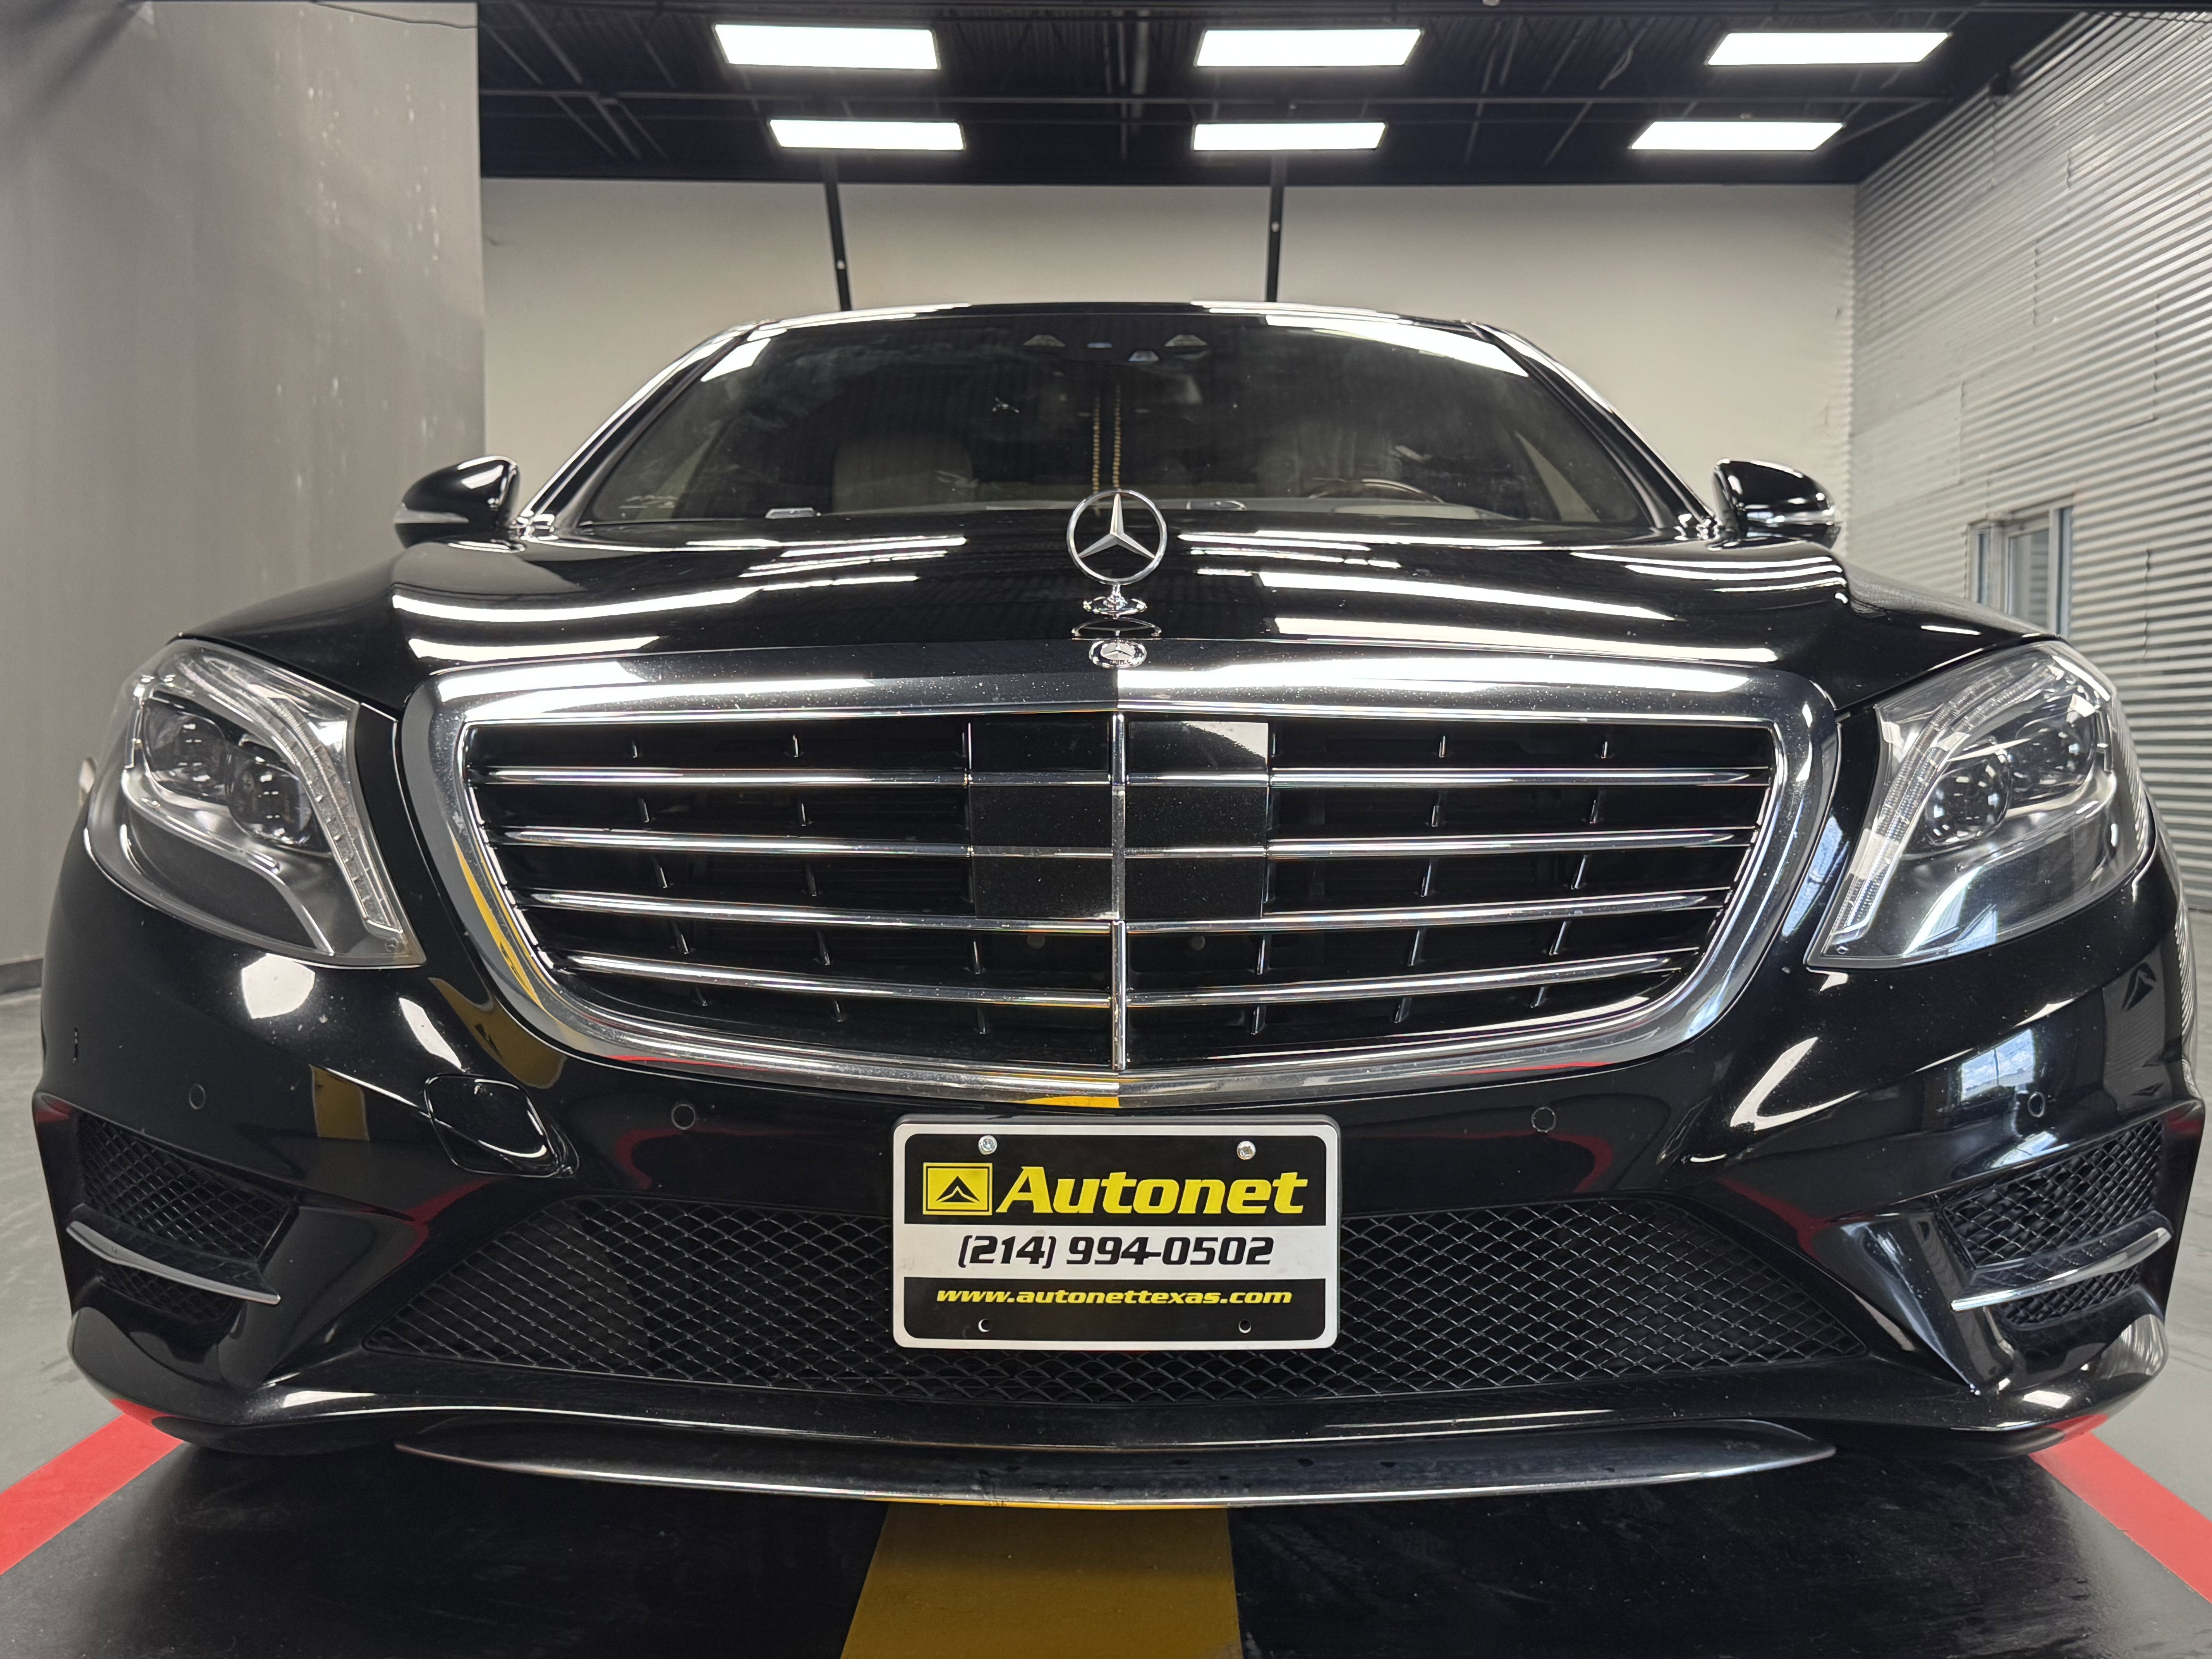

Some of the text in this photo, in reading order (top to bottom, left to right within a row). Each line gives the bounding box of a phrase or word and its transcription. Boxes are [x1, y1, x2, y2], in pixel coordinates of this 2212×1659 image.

[996, 1166, 1308, 1214] Autonet
[958, 1235, 1274, 1269] (214) 994-0502
[937, 1289, 1292, 1304] www.autonettexas.com
